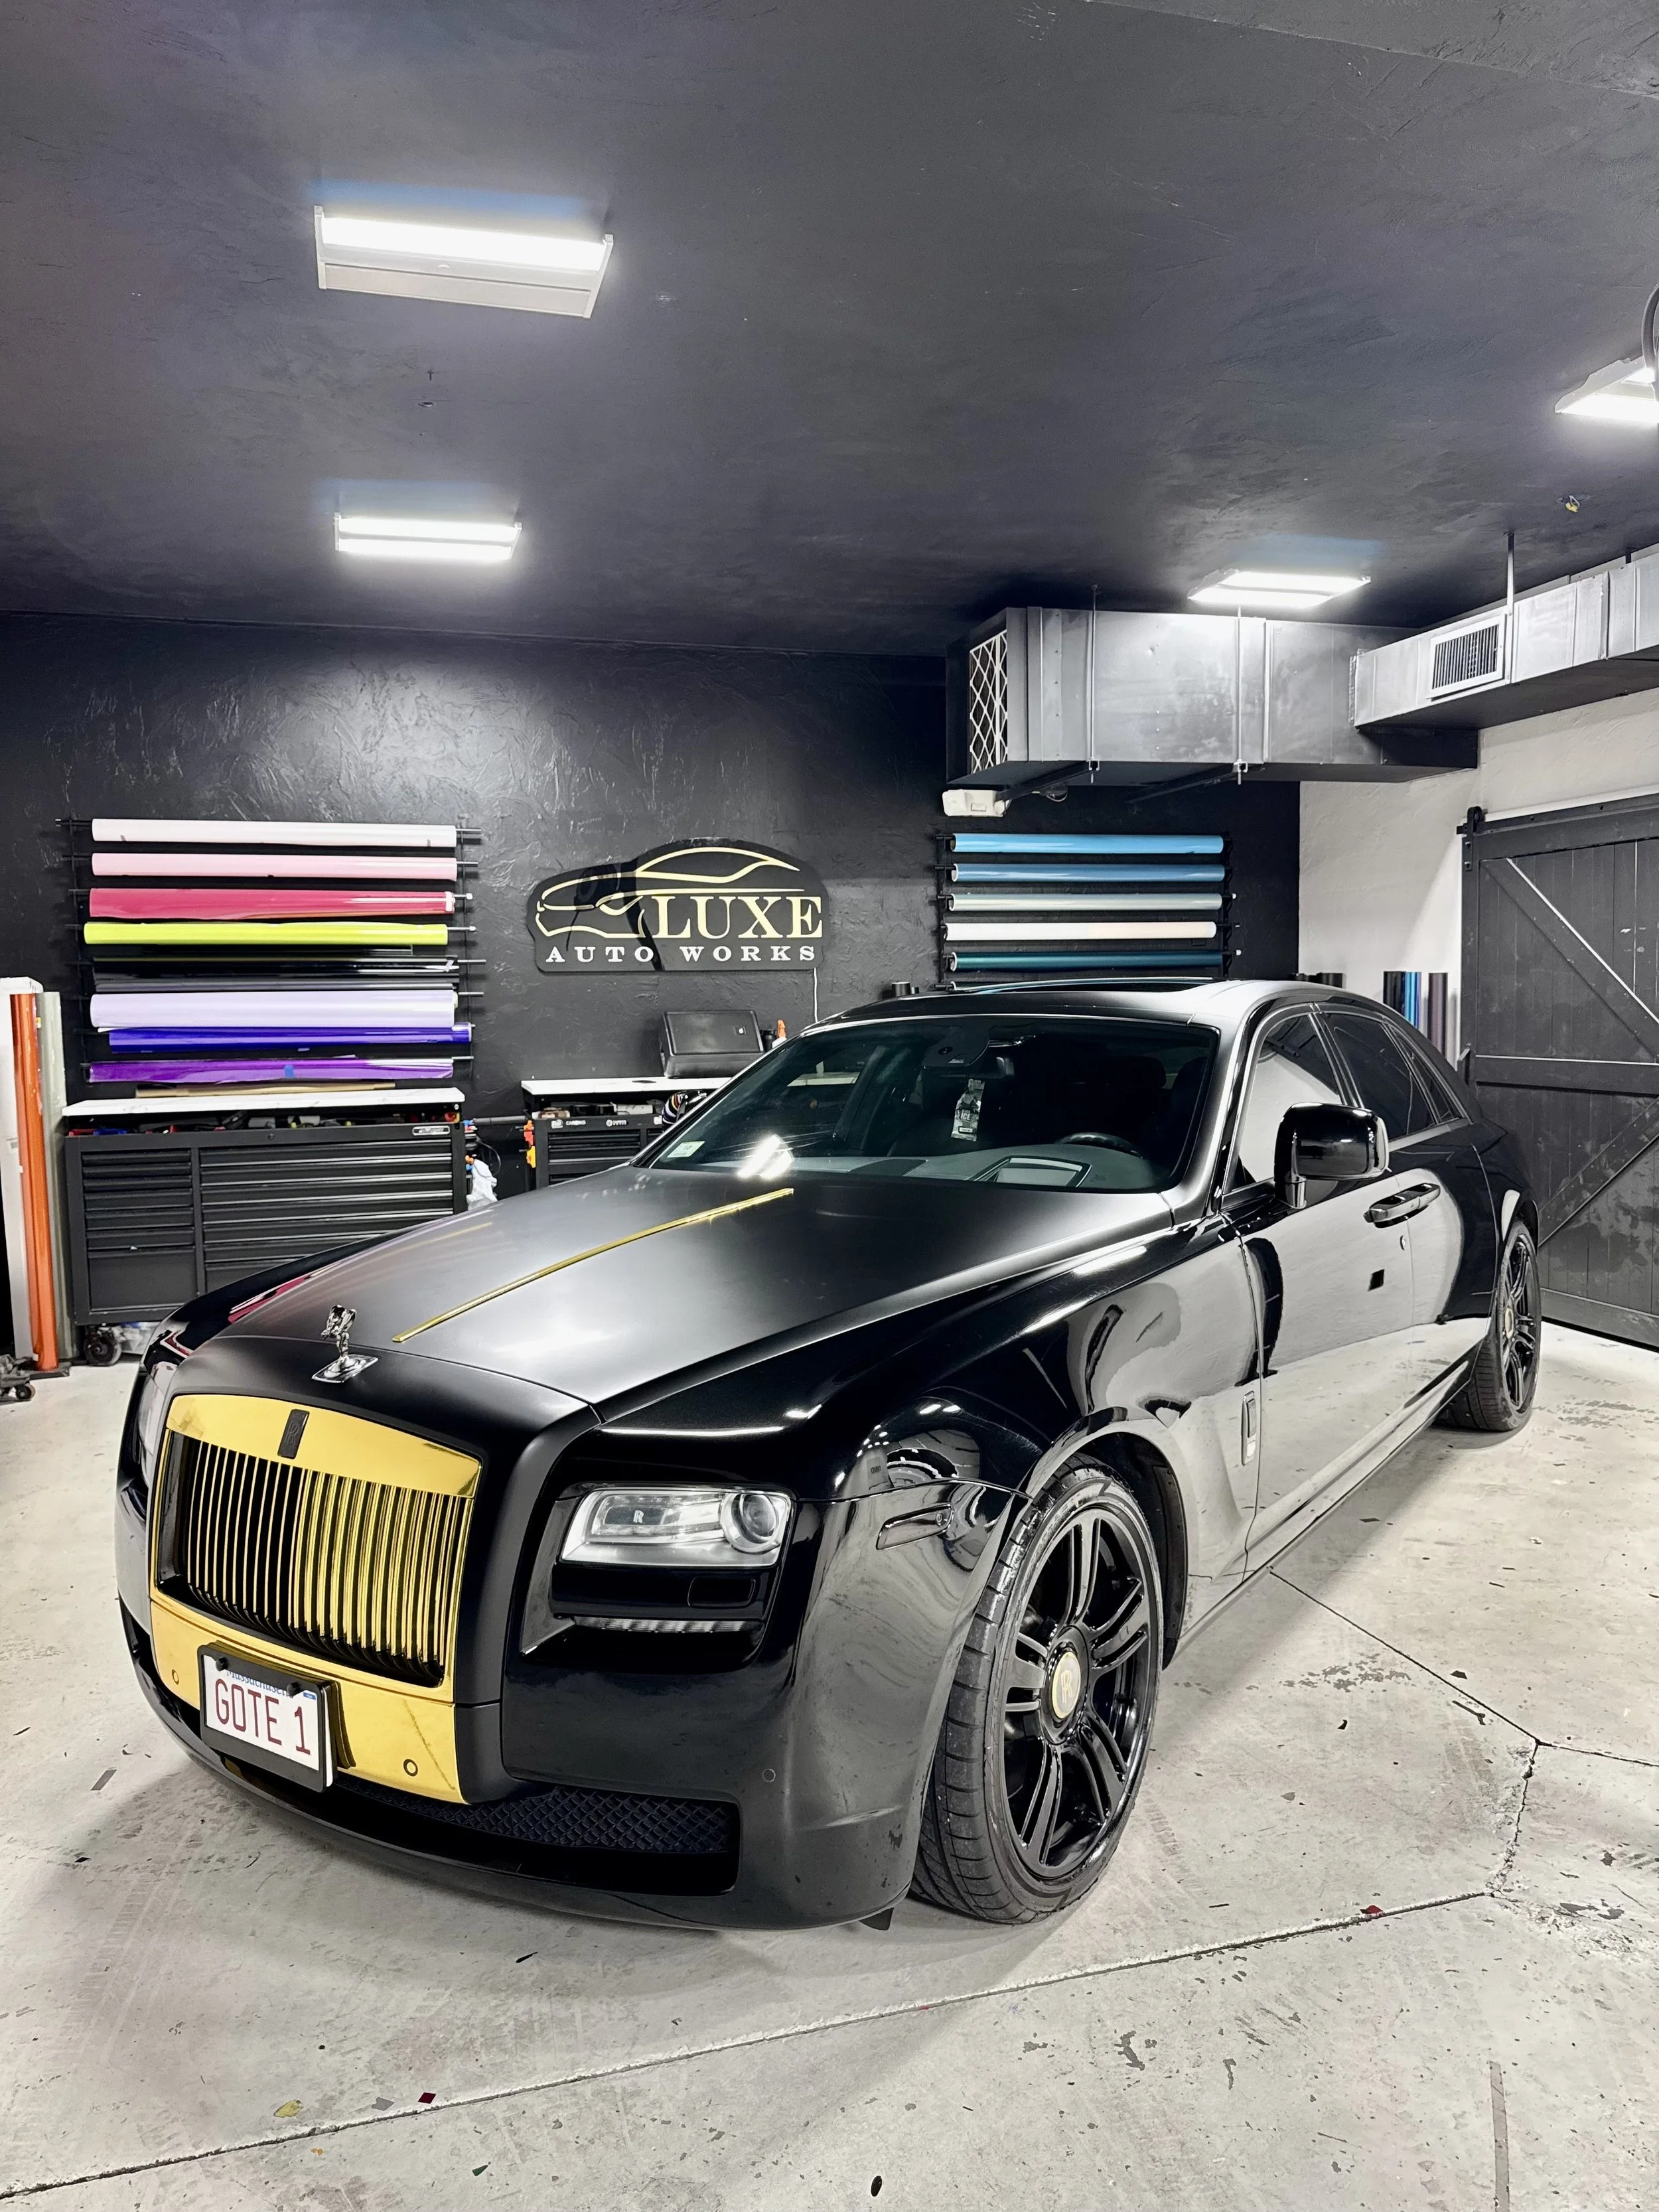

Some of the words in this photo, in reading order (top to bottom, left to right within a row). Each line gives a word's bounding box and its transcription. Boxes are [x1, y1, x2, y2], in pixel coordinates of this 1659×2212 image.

[651, 895, 823, 939] LUXE
[545, 946, 654, 963] AUTO
[679, 945, 816, 962] WORKS
[960, 1112, 972, 1121] ICE
[293, 1706, 311, 1755] 1
